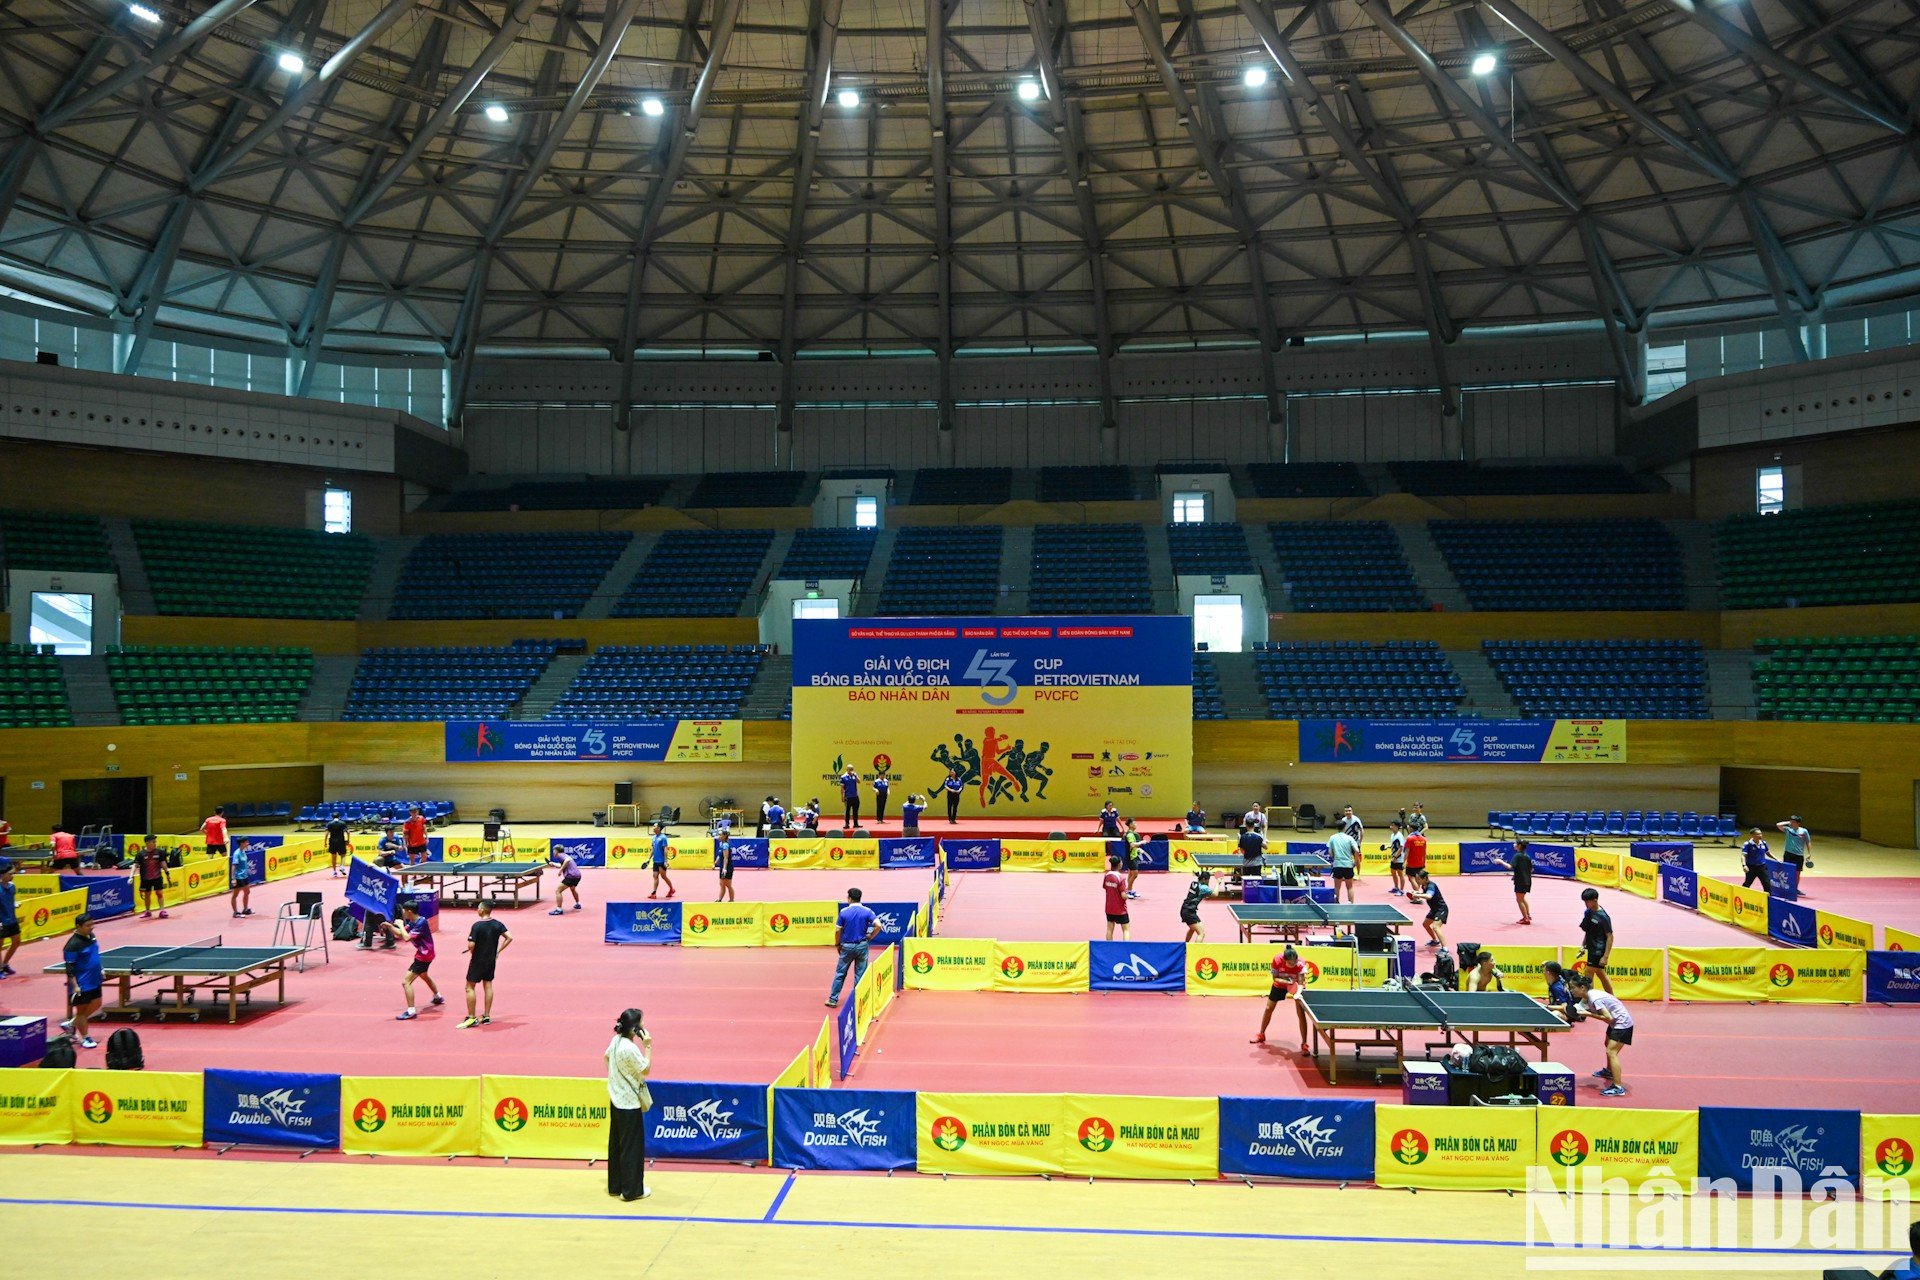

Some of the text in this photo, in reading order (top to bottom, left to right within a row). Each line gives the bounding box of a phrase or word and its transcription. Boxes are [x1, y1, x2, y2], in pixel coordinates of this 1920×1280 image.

[864, 655, 950, 672] GIẢI VÔ ĐỊCH
[1034, 659, 1063, 670] CUP
[812, 670, 950, 686] BÓNG BÀN QUỐC GIA
[963, 649, 1018, 706] 43
[1034, 674, 1140, 686] PETROVIETNAM
[848, 688, 950, 701] BÁO NHÂN DÂN
[1034, 690, 1079, 701] PVCFC
[1887, 980, 1920, 989] Double
[118, 1097, 187, 1112] PHÂN BÓN CÀ MAU
[1551, 1096, 1563, 1105] 27
[392, 1103, 463, 1118] PHÂN BÓN CÀ MAU
[533, 1104, 606, 1119] PHÂN BÓN CÀ MAU
[229, 1111, 312, 1126] Double FISH
[654, 1125, 742, 1139] Double FISH
[972, 1121, 1050, 1137] PHÂN BÓN CÀ MAU
[1120, 1124, 1200, 1140] PHÂN BÓN CÀ MAU
[862, 1135, 887, 1146] FISH
[1435, 1136, 1517, 1152] PHÂN BÓN CÀ MAU
[1595, 1137, 1678, 1154] PHÂN BÓN CÀ MAU
[1249, 1142, 1343, 1157] Double FISH
[1800, 1158, 1824, 1170] FISH
